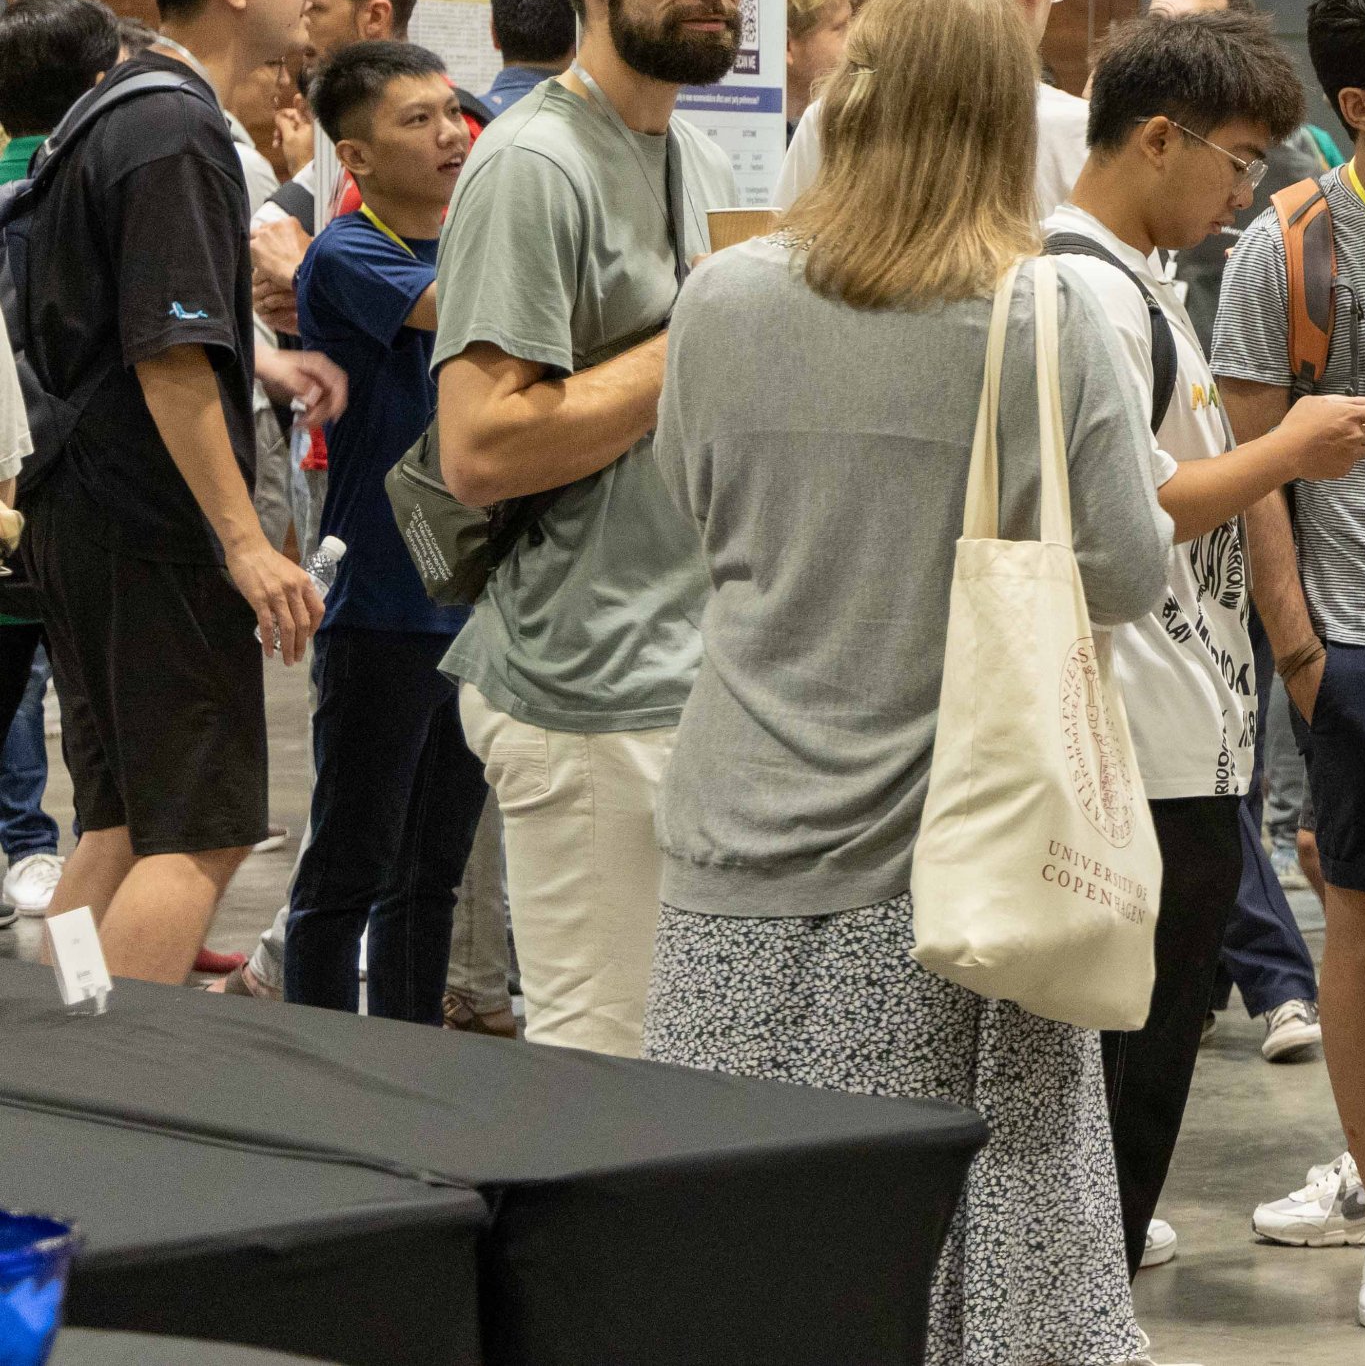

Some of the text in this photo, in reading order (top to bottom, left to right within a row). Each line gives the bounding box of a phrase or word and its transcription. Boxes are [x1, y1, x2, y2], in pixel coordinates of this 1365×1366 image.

[418, 521, 449, 581] Recommender
[421, 520, 433, 537] ACM
[431, 537, 453, 577] Conference
[425, 557, 439, 580] 2023
[1042, 864, 1146, 926] COPENHAGEN
[1049, 840, 1134, 894] UNIVERSITY
